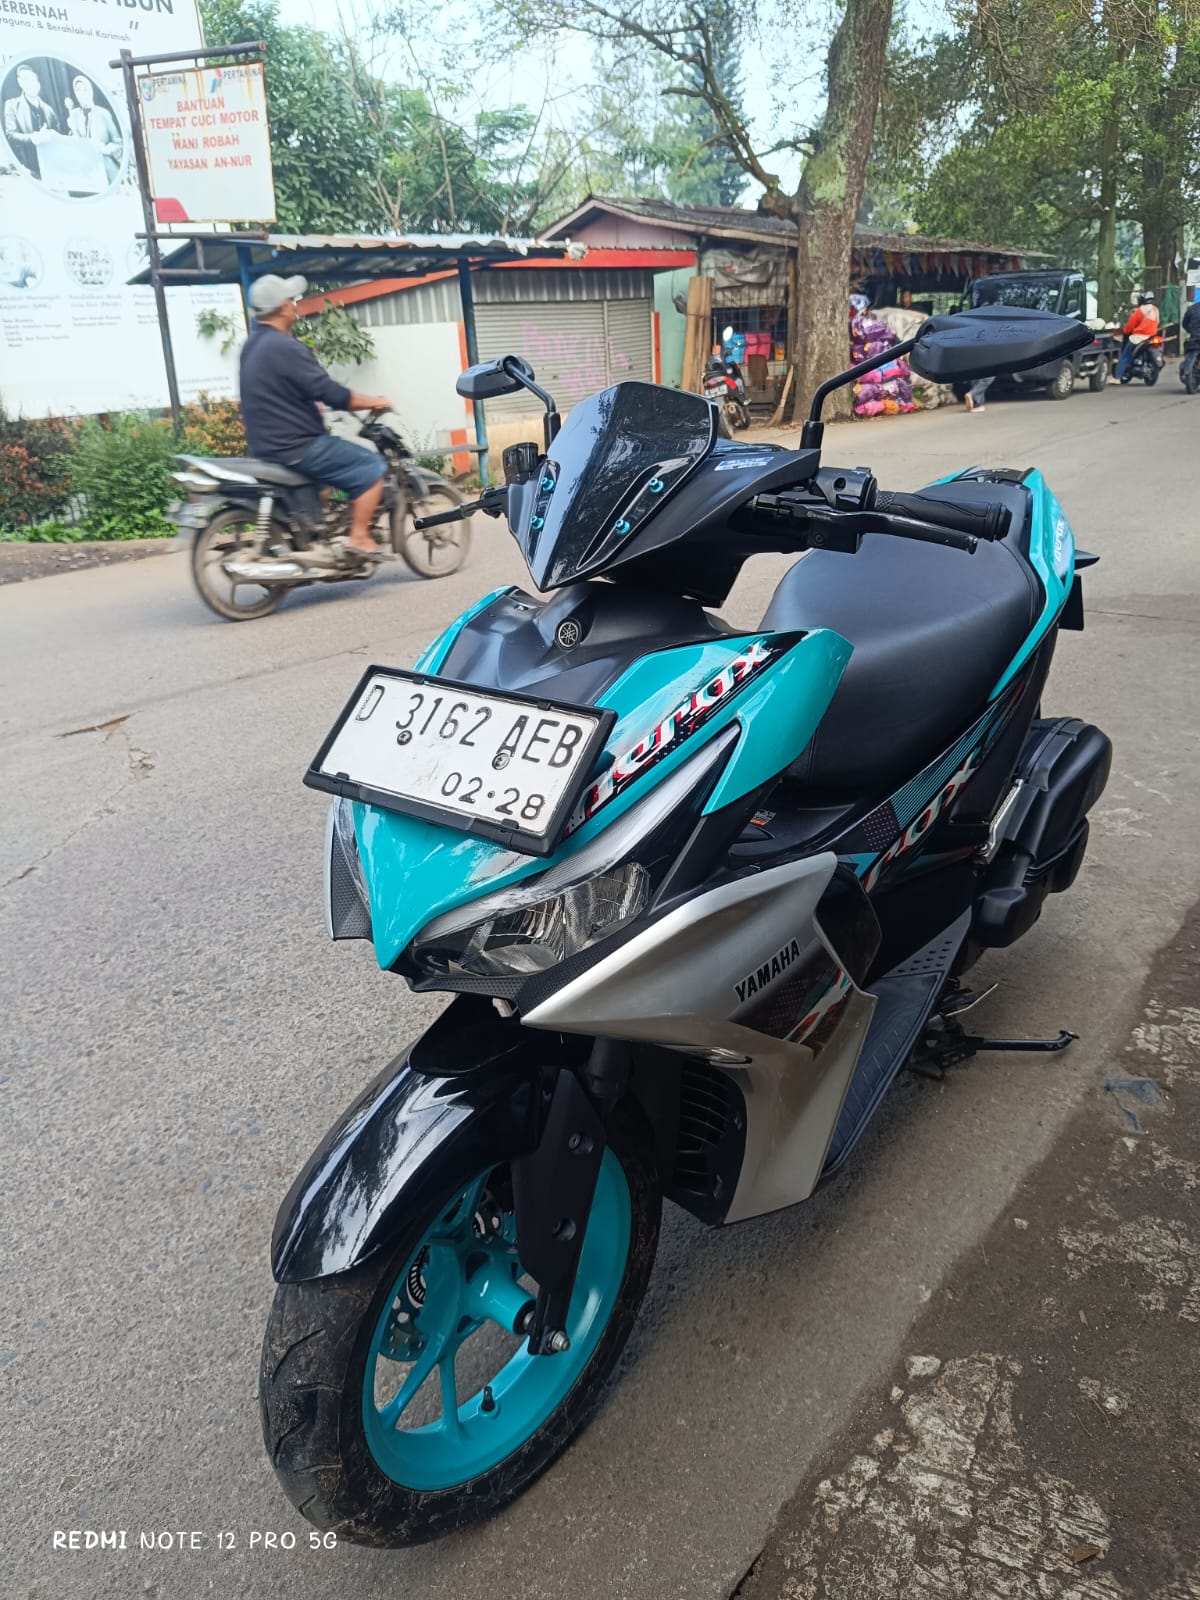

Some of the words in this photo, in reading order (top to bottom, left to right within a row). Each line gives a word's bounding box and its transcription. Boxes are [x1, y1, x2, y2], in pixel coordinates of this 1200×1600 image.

[37, 20, 44, 29] &
[176, 96, 225, 112] BANTUAN
[149, 117, 187, 130] TEMPAT
[191, 115, 216, 126] CUCI
[220, 110, 259, 125] MOTOR
[172, 137, 199, 150] WANI
[202, 135, 240, 149] ROBAH
[167, 158, 209, 170] YAYASAN
[214, 154, 252, 169] AN-NUR
[355, 685, 385, 722] D
[396, 693, 492, 747] 3162
[496, 715, 583, 769] AEB
[735, 940, 800, 1003] YAMAHA
